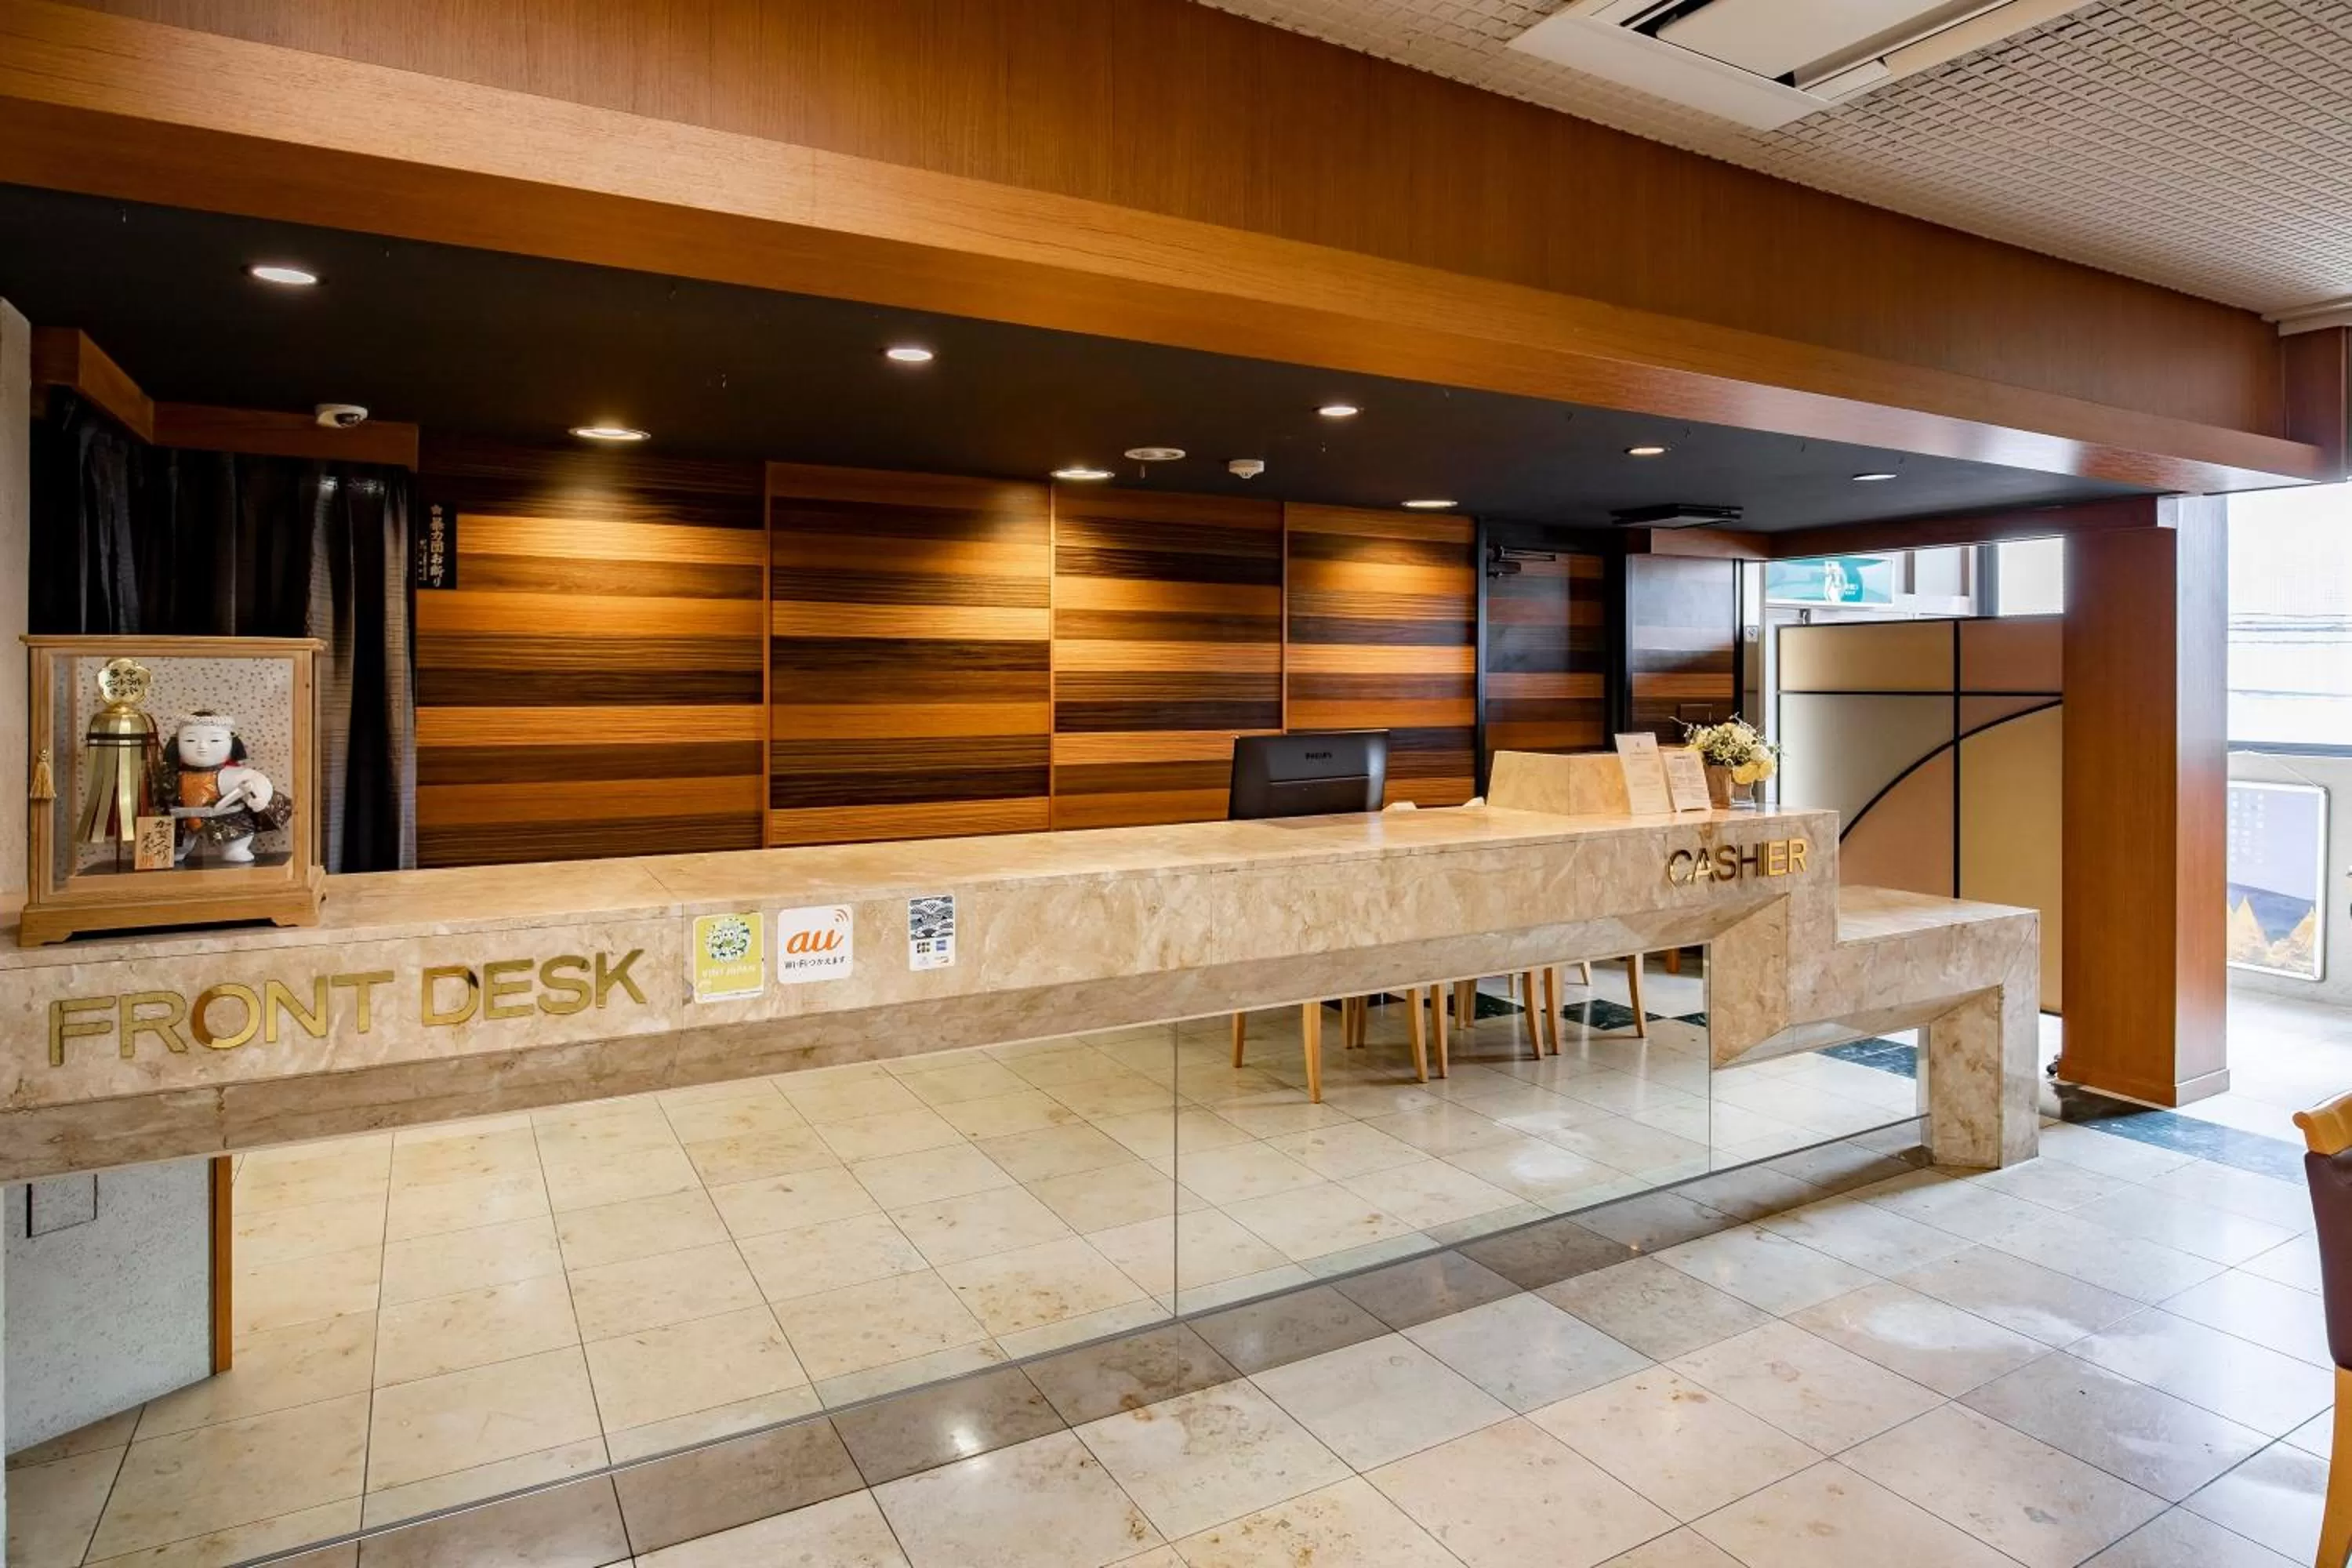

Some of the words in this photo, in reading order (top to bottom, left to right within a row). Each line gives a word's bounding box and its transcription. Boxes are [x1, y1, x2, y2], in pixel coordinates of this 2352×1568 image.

[1665, 838, 1808, 888] CASHIER
[786, 928, 844, 954] au
[49, 969, 395, 1067] FRONT
[421, 948, 647, 1027] DESK
